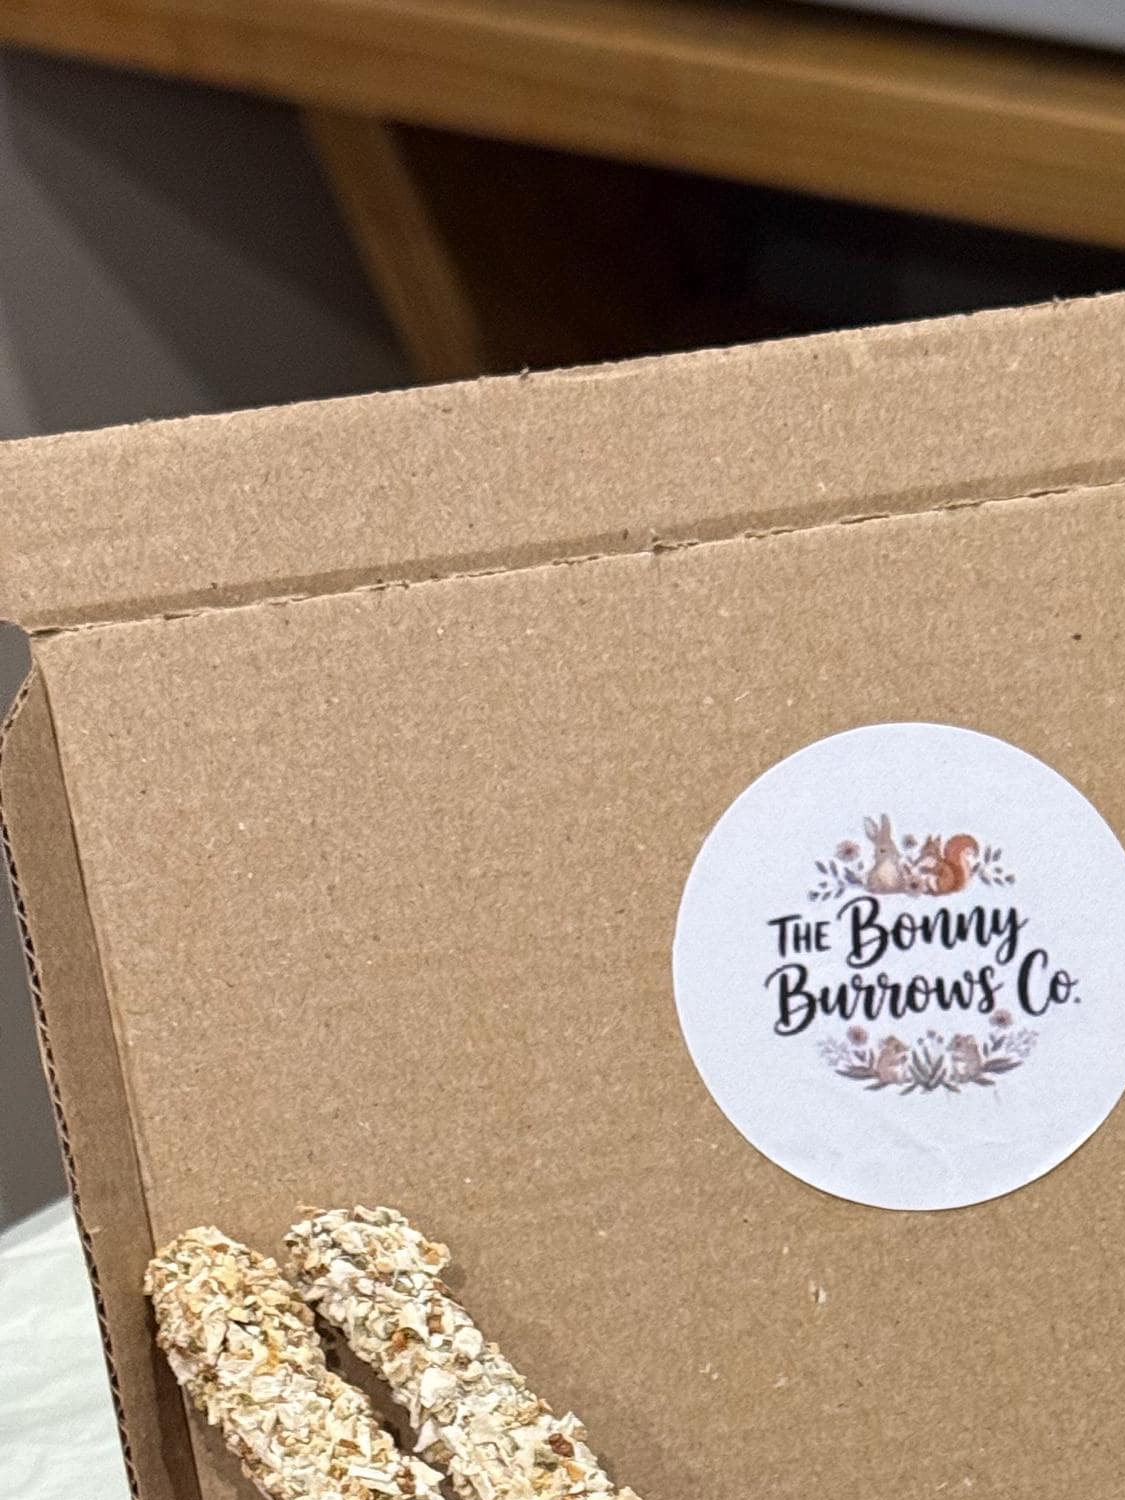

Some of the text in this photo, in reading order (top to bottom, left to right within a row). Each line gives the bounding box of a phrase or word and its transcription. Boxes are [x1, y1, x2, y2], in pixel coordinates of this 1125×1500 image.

[767, 895, 1029, 969] THE Bonny
[764, 948, 1082, 1036] Burrows Co.
